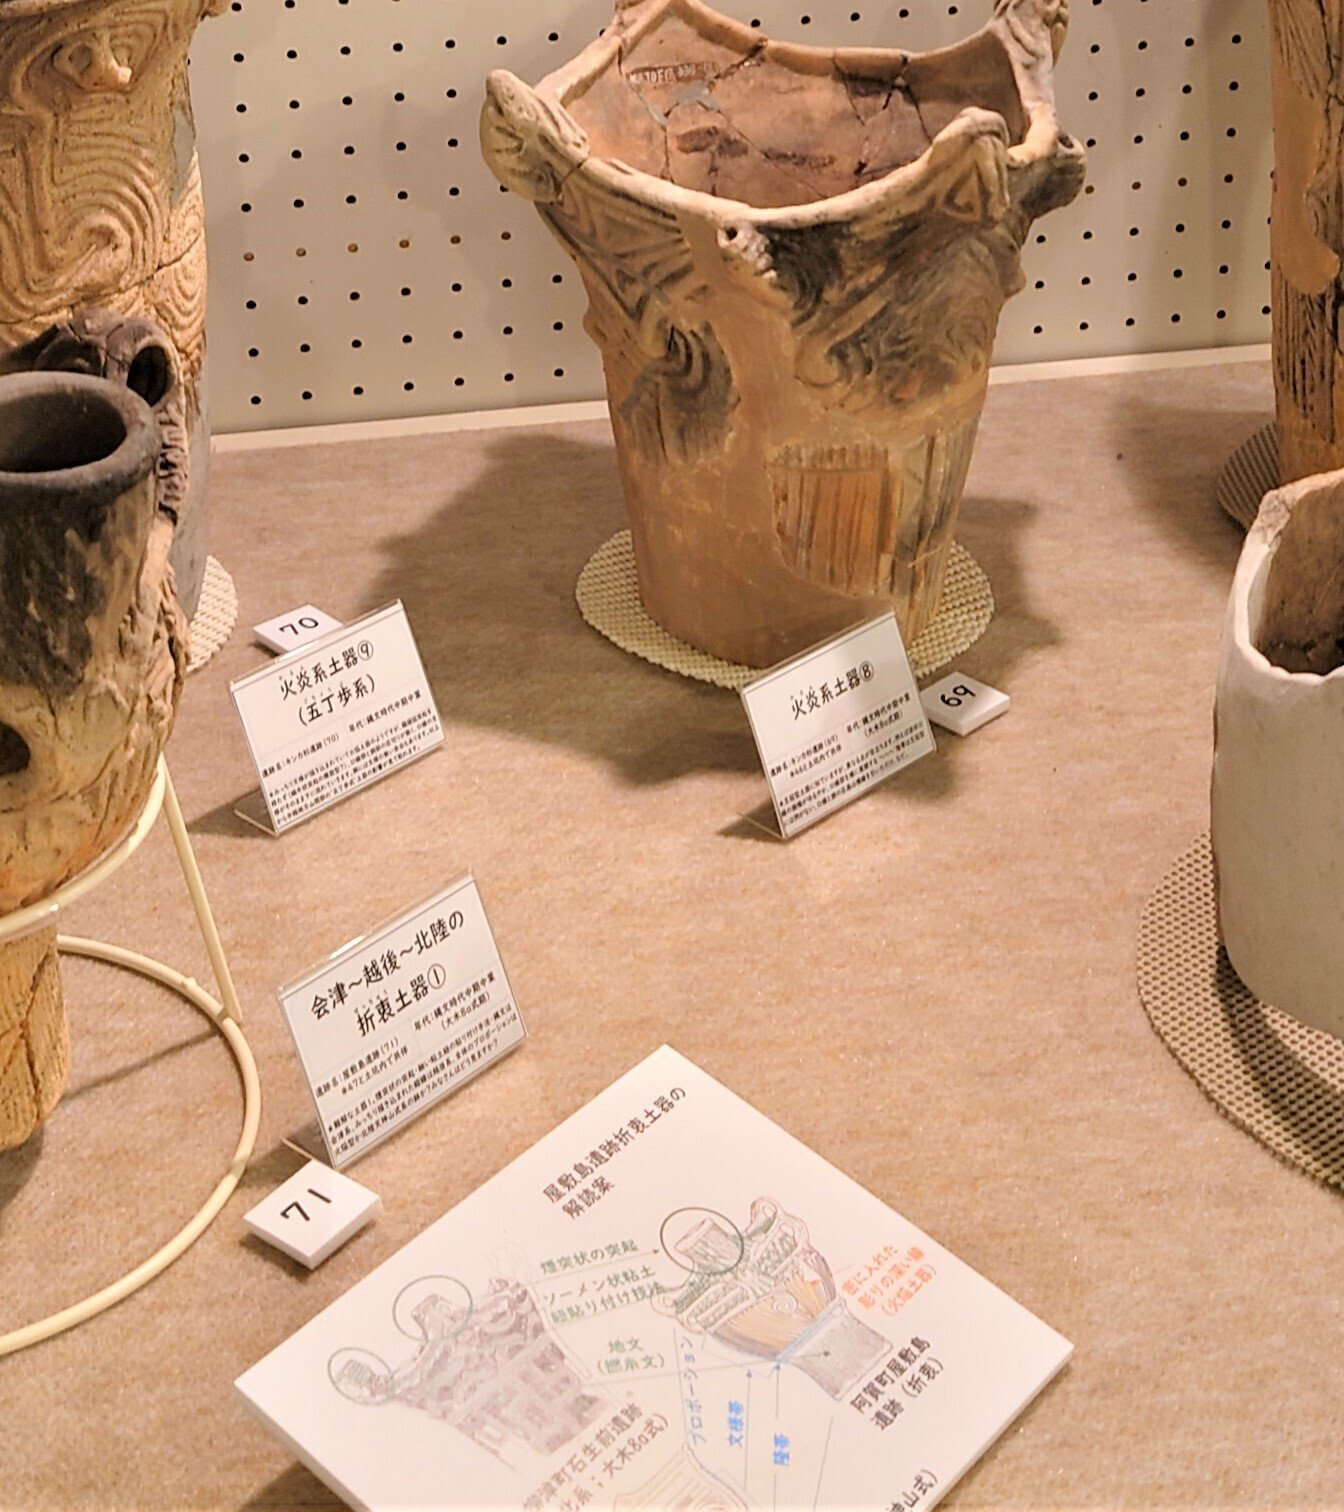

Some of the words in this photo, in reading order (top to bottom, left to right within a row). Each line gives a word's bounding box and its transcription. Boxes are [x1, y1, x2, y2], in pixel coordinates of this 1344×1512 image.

[279, 616, 320, 636] 70
[940, 683, 977, 707] 69
[280, 1187, 332, 1222] 71
